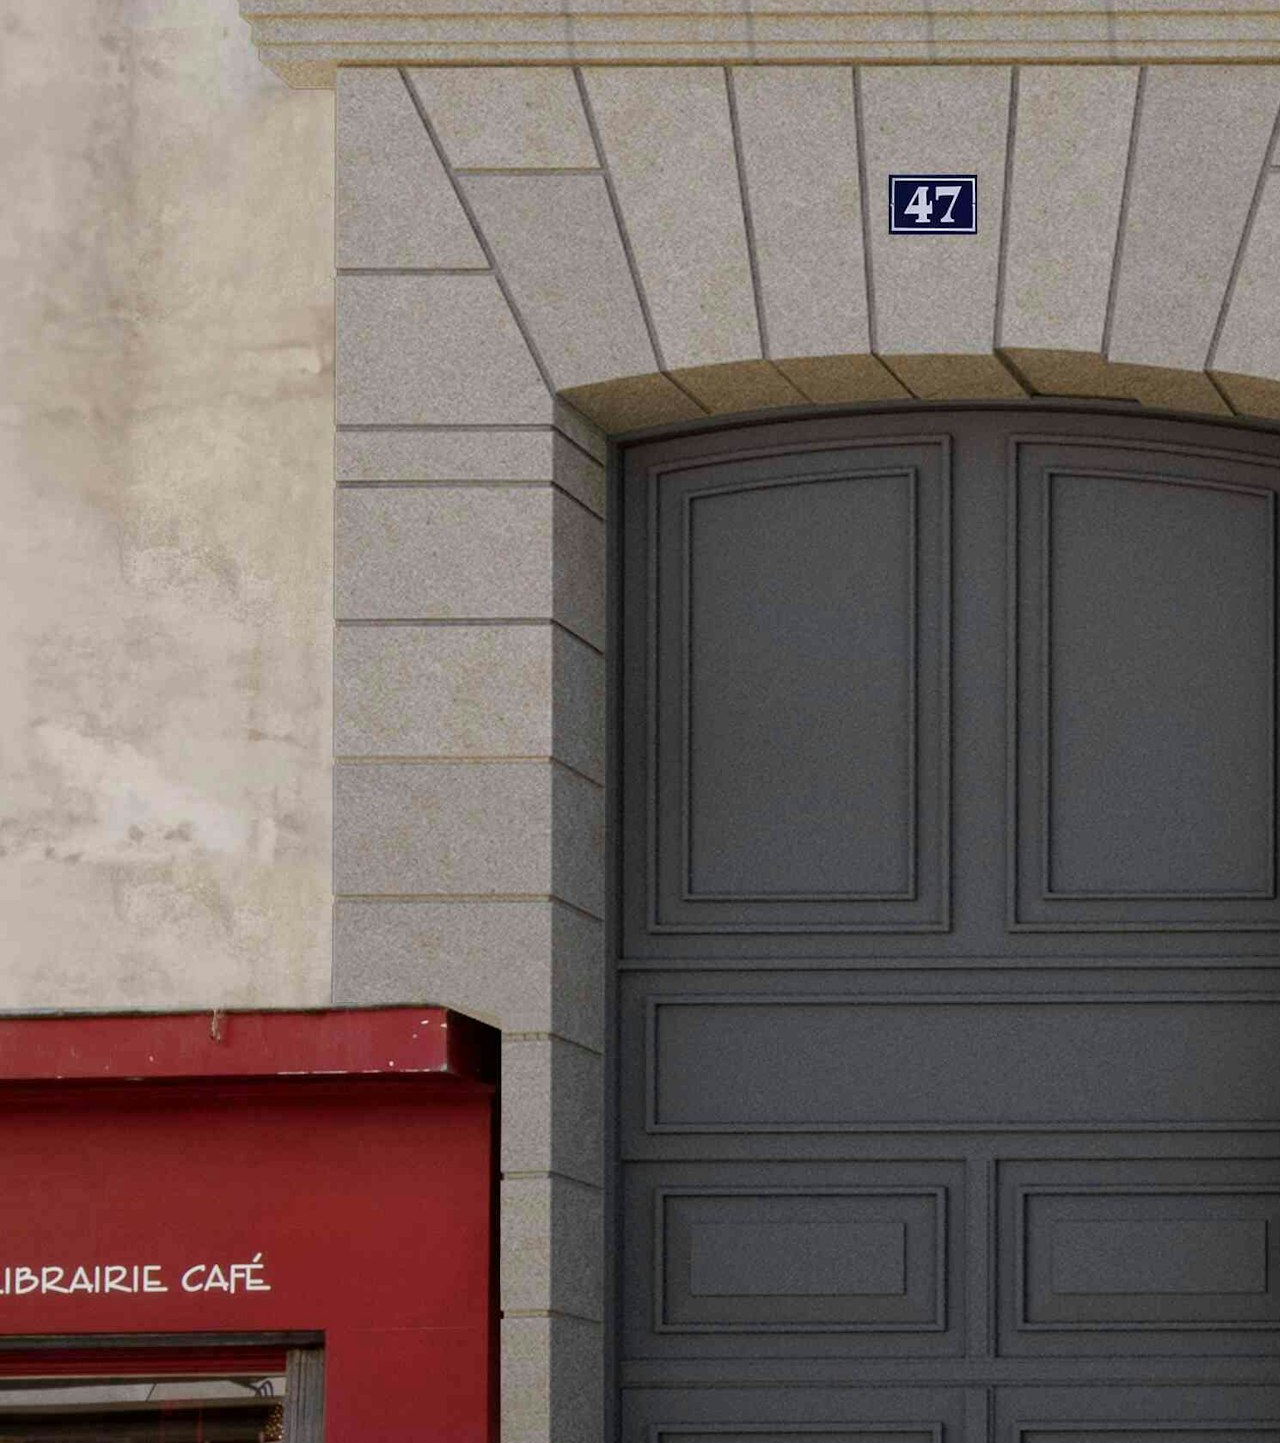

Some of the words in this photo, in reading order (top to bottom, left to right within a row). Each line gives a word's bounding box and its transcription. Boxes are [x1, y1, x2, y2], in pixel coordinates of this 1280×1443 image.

[904, 186, 962, 223] 47
[0, 1265, 168, 1295] IBRAIRIE
[181, 1252, 271, 1294] CAFÉ
